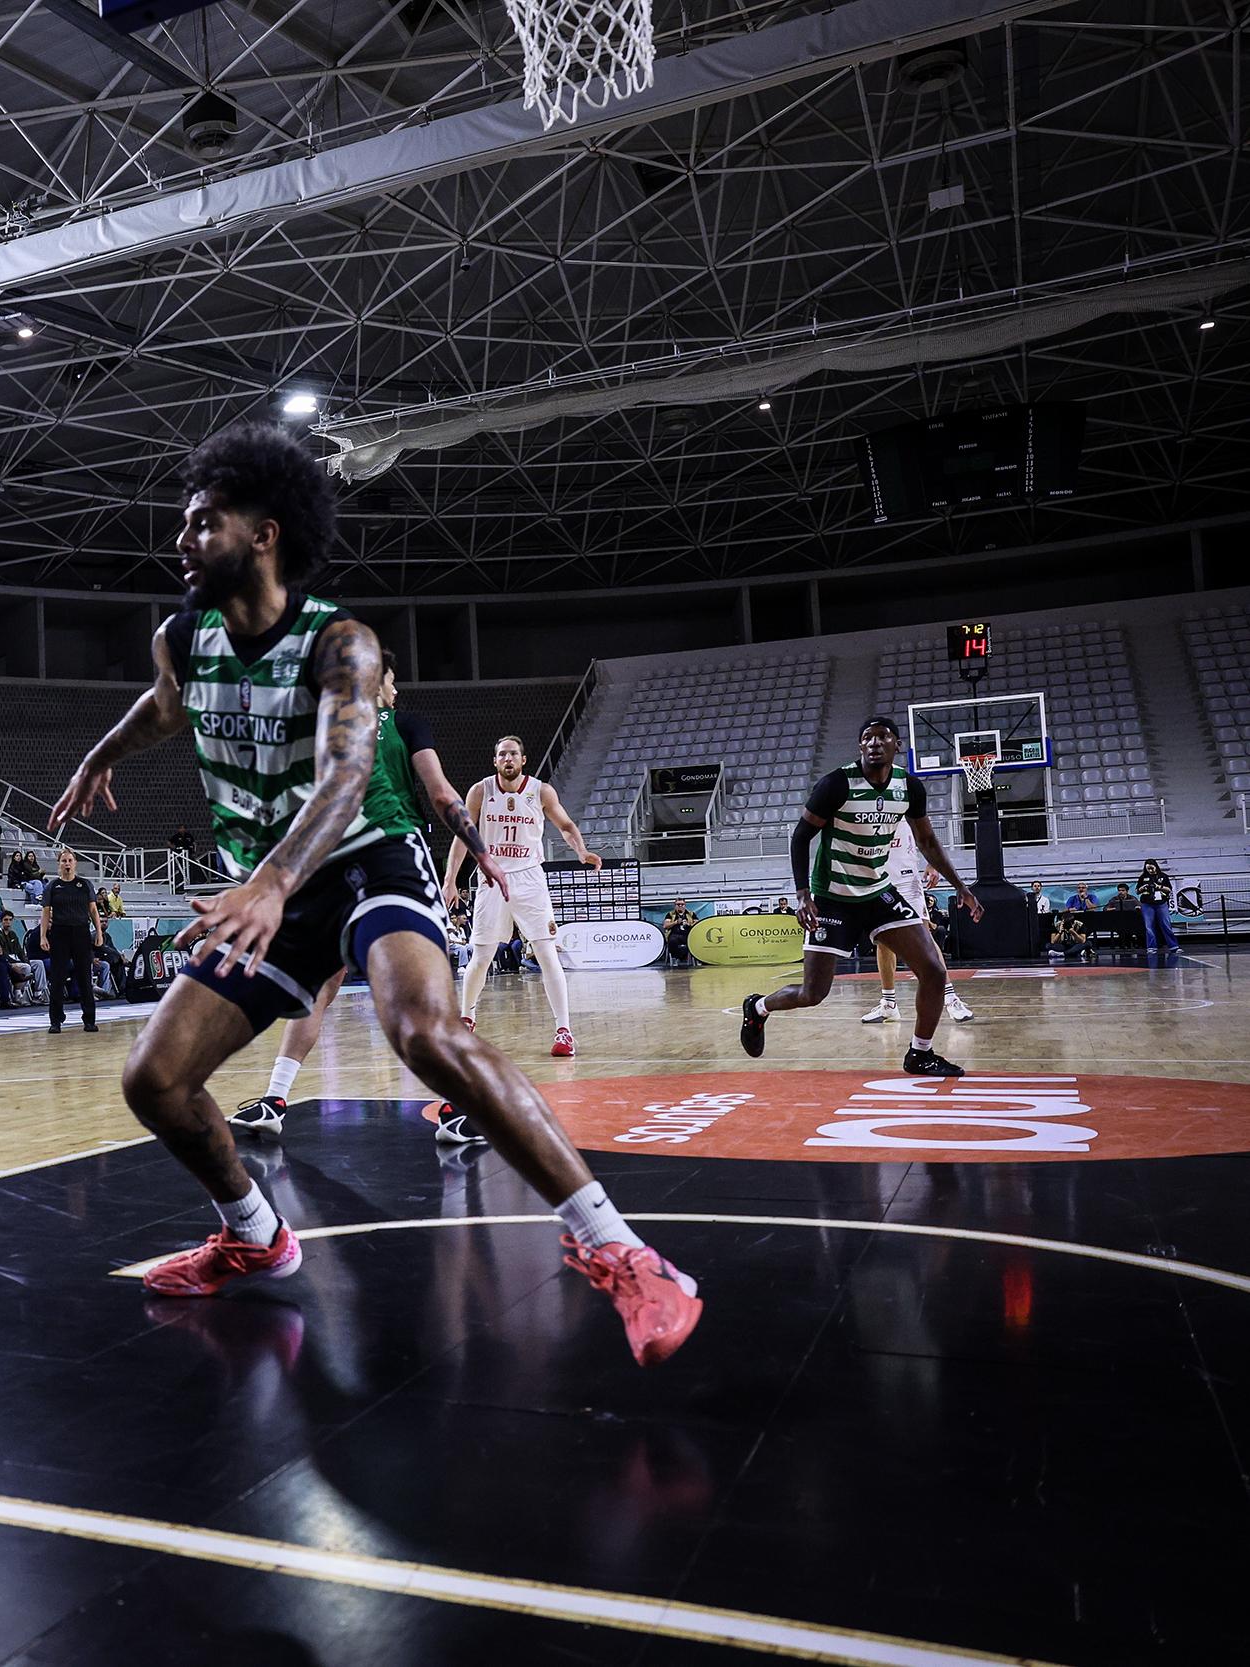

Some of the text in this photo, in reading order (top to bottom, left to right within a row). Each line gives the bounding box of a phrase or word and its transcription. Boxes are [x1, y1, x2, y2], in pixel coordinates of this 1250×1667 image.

[965, 639, 986, 657] 14
[200, 711, 287, 744] SPORTING
[486, 814, 535, 825] SL BENFICA
[854, 812, 899, 823] SPORTING
[503, 825, 517, 842] 11
[489, 844, 530, 858] RAMIREZ
[593, 933, 652, 943] GONDOMAR
[739, 928, 804, 938] GONDOMAR
[612, 1092, 756, 1145] seguros
